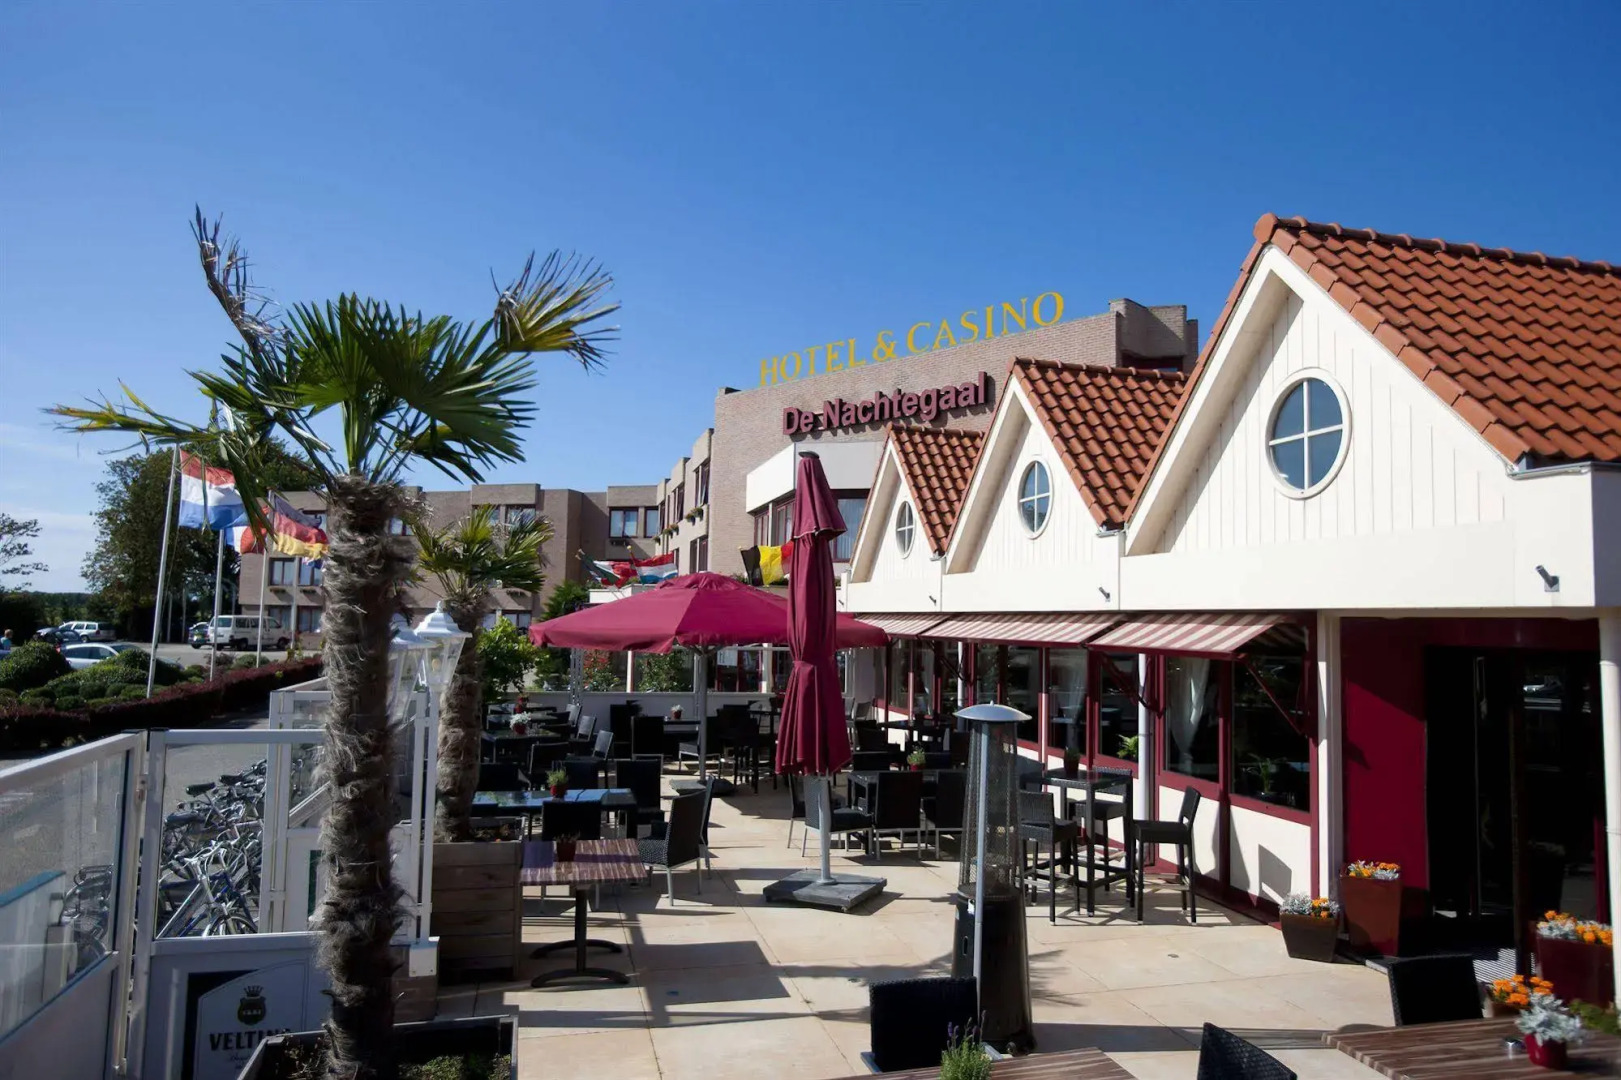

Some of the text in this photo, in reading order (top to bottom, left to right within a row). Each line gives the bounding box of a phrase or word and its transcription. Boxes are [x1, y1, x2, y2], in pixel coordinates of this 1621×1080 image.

[759, 292, 1065, 387] HOTEL & CASINO
[783, 371, 989, 435] De Nachtegaal
[209, 1028, 291, 1051] VELTI
